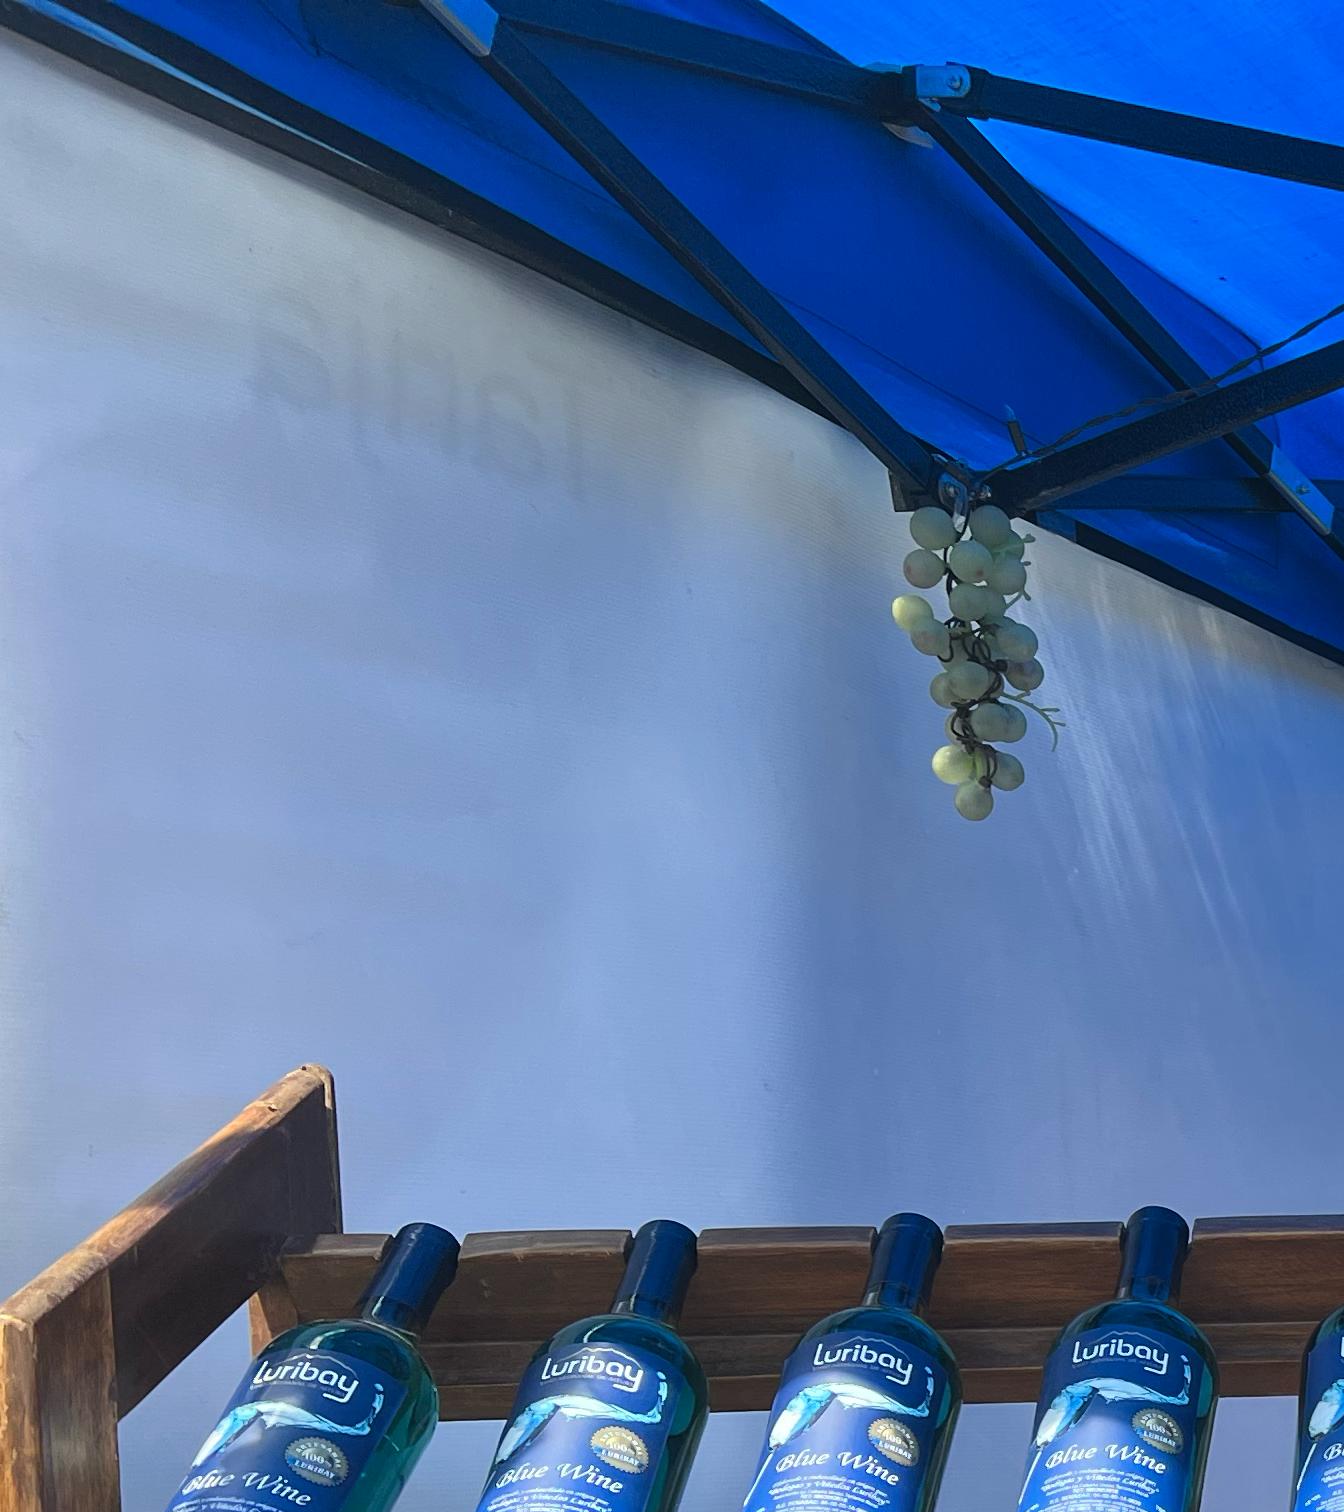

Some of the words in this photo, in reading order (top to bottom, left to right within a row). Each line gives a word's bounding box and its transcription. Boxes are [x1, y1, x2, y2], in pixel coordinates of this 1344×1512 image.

[541, 1356, 644, 1392] Luribay
[813, 1343, 914, 1385] Luribay
[1072, 1338, 1169, 1375] Luribay
[252, 1360, 358, 1403] Luribay
[776, 1449, 829, 1473] Blue
[837, 1451, 899, 1486] Wine
[1045, 1444, 1097, 1469] Blue
[1104, 1444, 1167, 1475] Wine
[181, 1469, 234, 1496] Blue
[241, 1471, 311, 1505] Wine
[495, 1463, 548, 1488] Blue
[556, 1463, 623, 1493] Wine
